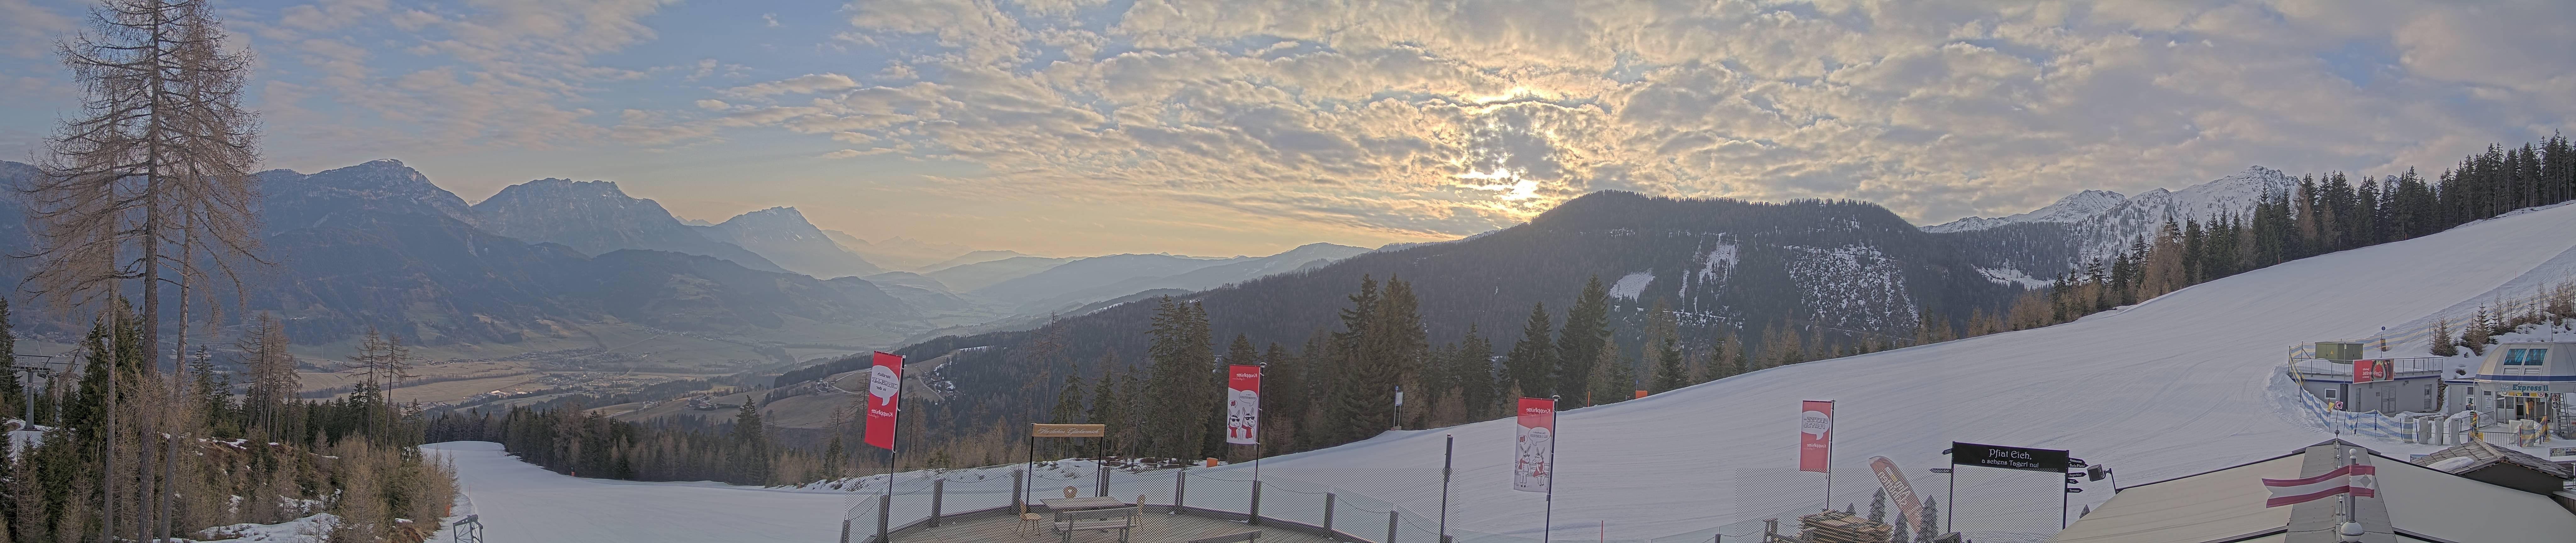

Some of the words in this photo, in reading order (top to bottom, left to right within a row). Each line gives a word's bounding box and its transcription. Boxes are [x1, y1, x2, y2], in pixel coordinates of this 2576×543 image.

[2512, 384, 2542, 392] Express
[1989, 449, 2008, 458] Pfiat
[2011, 451, 2032, 460] Eich,
